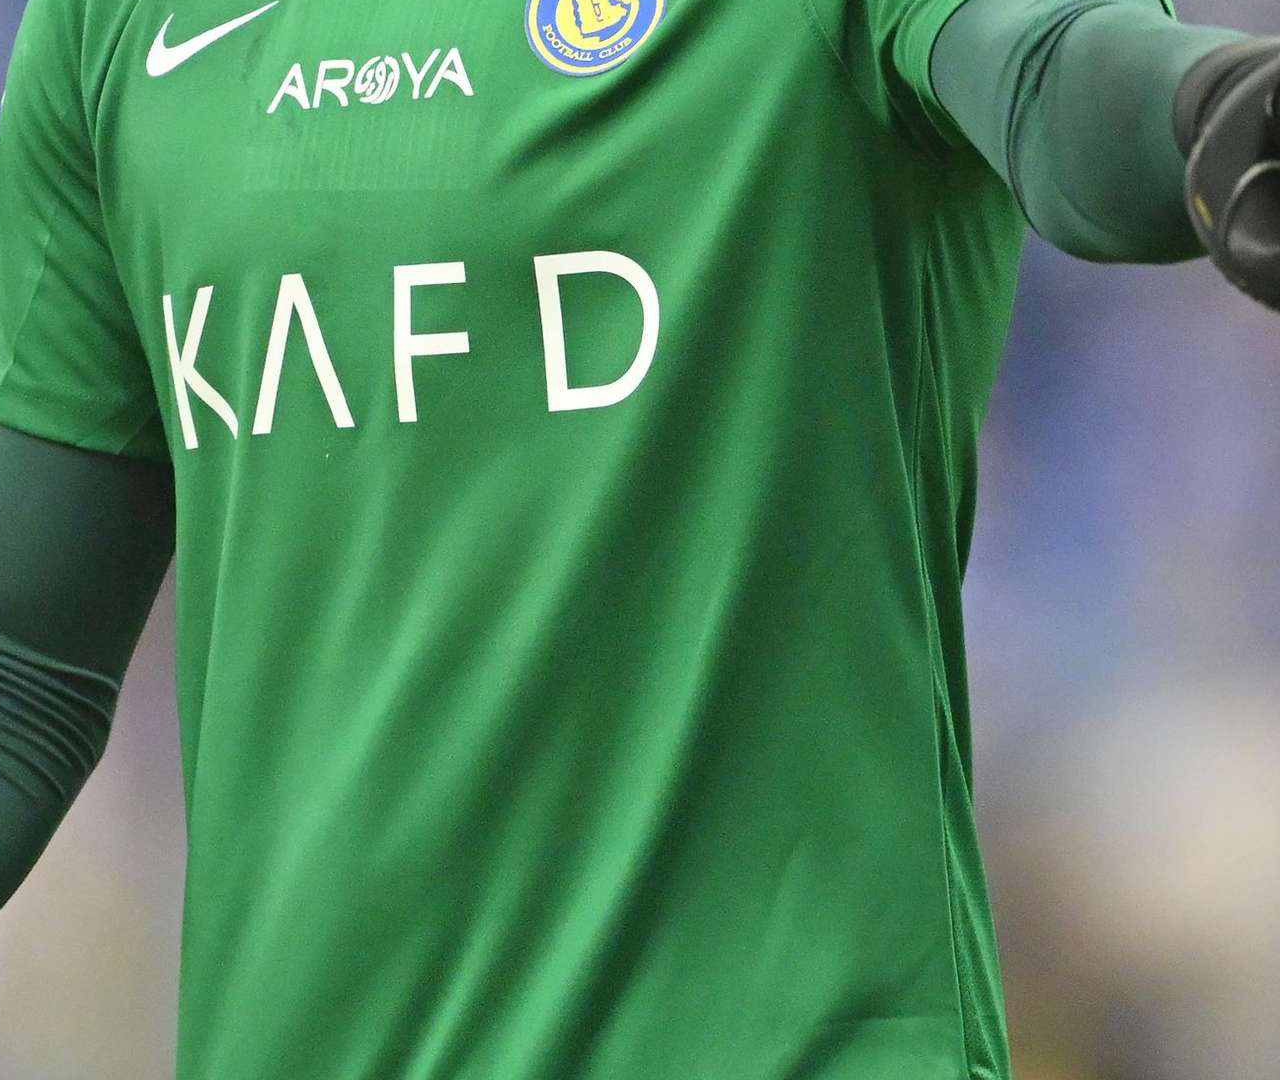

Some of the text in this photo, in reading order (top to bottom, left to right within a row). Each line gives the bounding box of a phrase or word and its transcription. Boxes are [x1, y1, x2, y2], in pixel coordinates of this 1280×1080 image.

[543, 24, 593, 61] FOOTBALL
[266, 47, 474, 114] AROYA
[162, 250, 660, 450] KAFD
